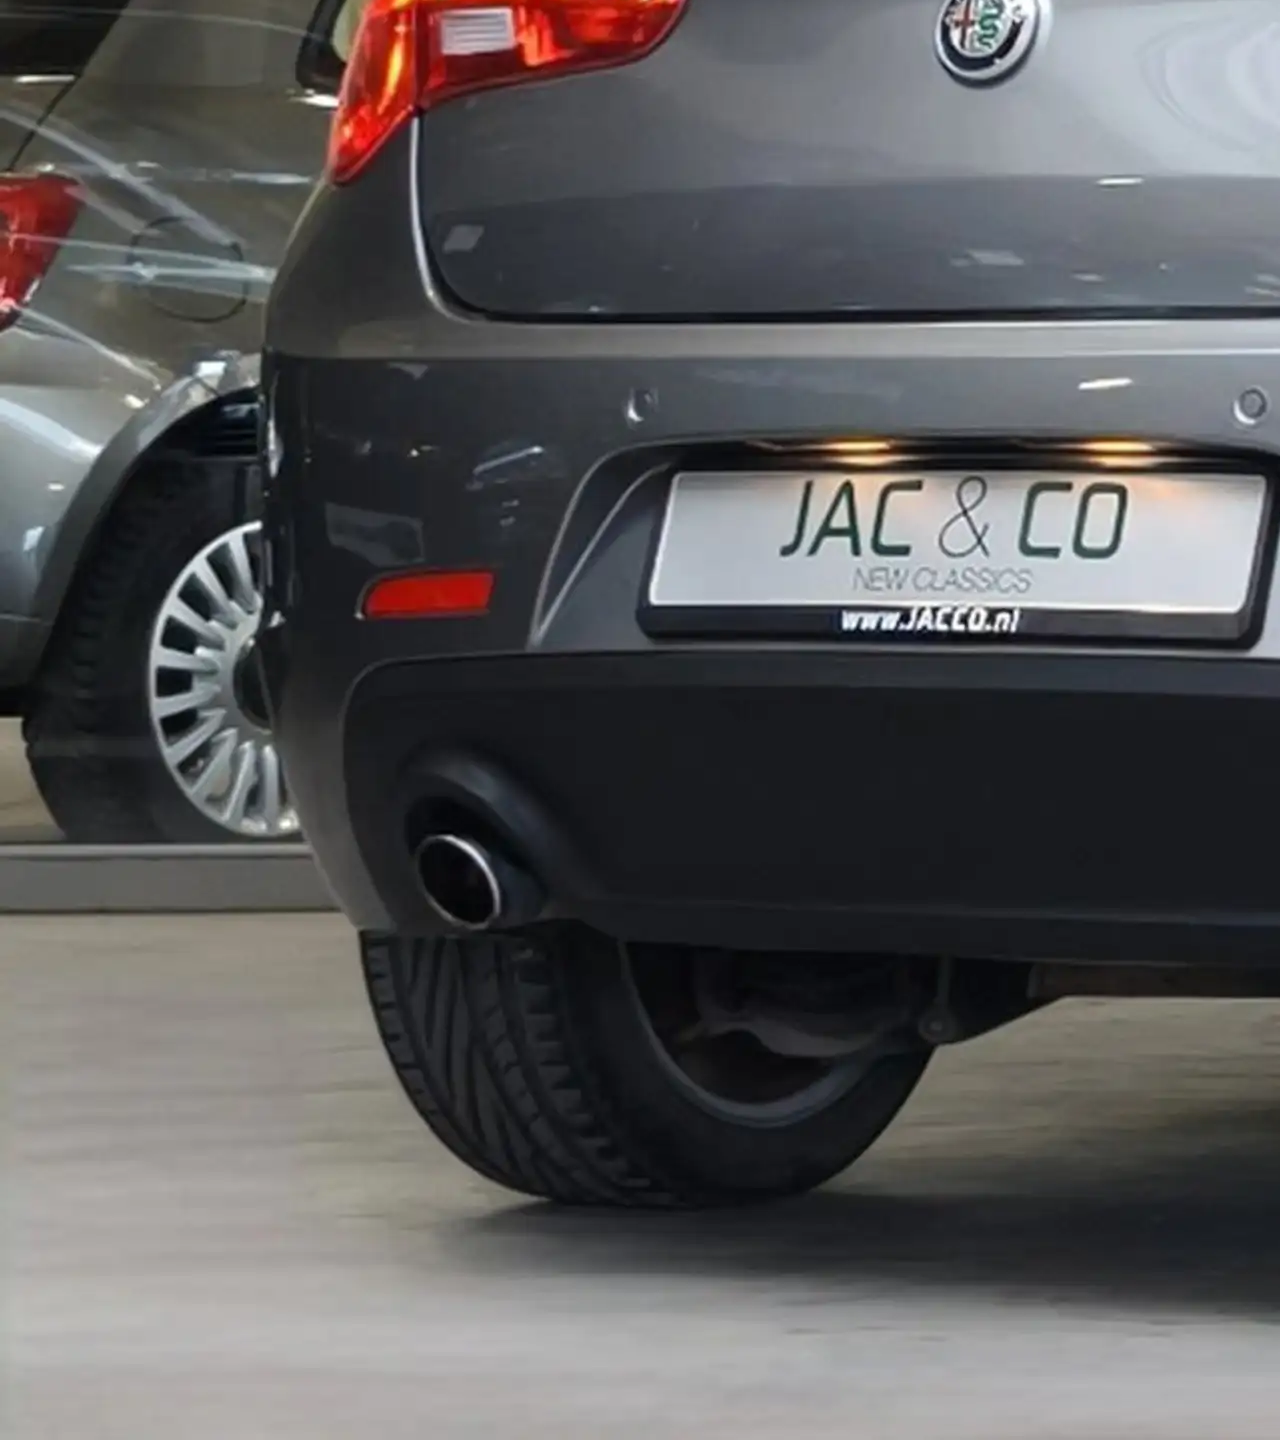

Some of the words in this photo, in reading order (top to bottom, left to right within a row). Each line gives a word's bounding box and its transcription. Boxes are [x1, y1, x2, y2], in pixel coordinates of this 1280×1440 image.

[780, 480, 923, 557] JAC
[938, 476, 991, 558] &
[1018, 481, 1128, 559] CO
[853, 566, 906, 591] NEW
[913, 567, 1032, 593] CLASSICS
[841, 606, 1020, 633] www.JACCO.nl
